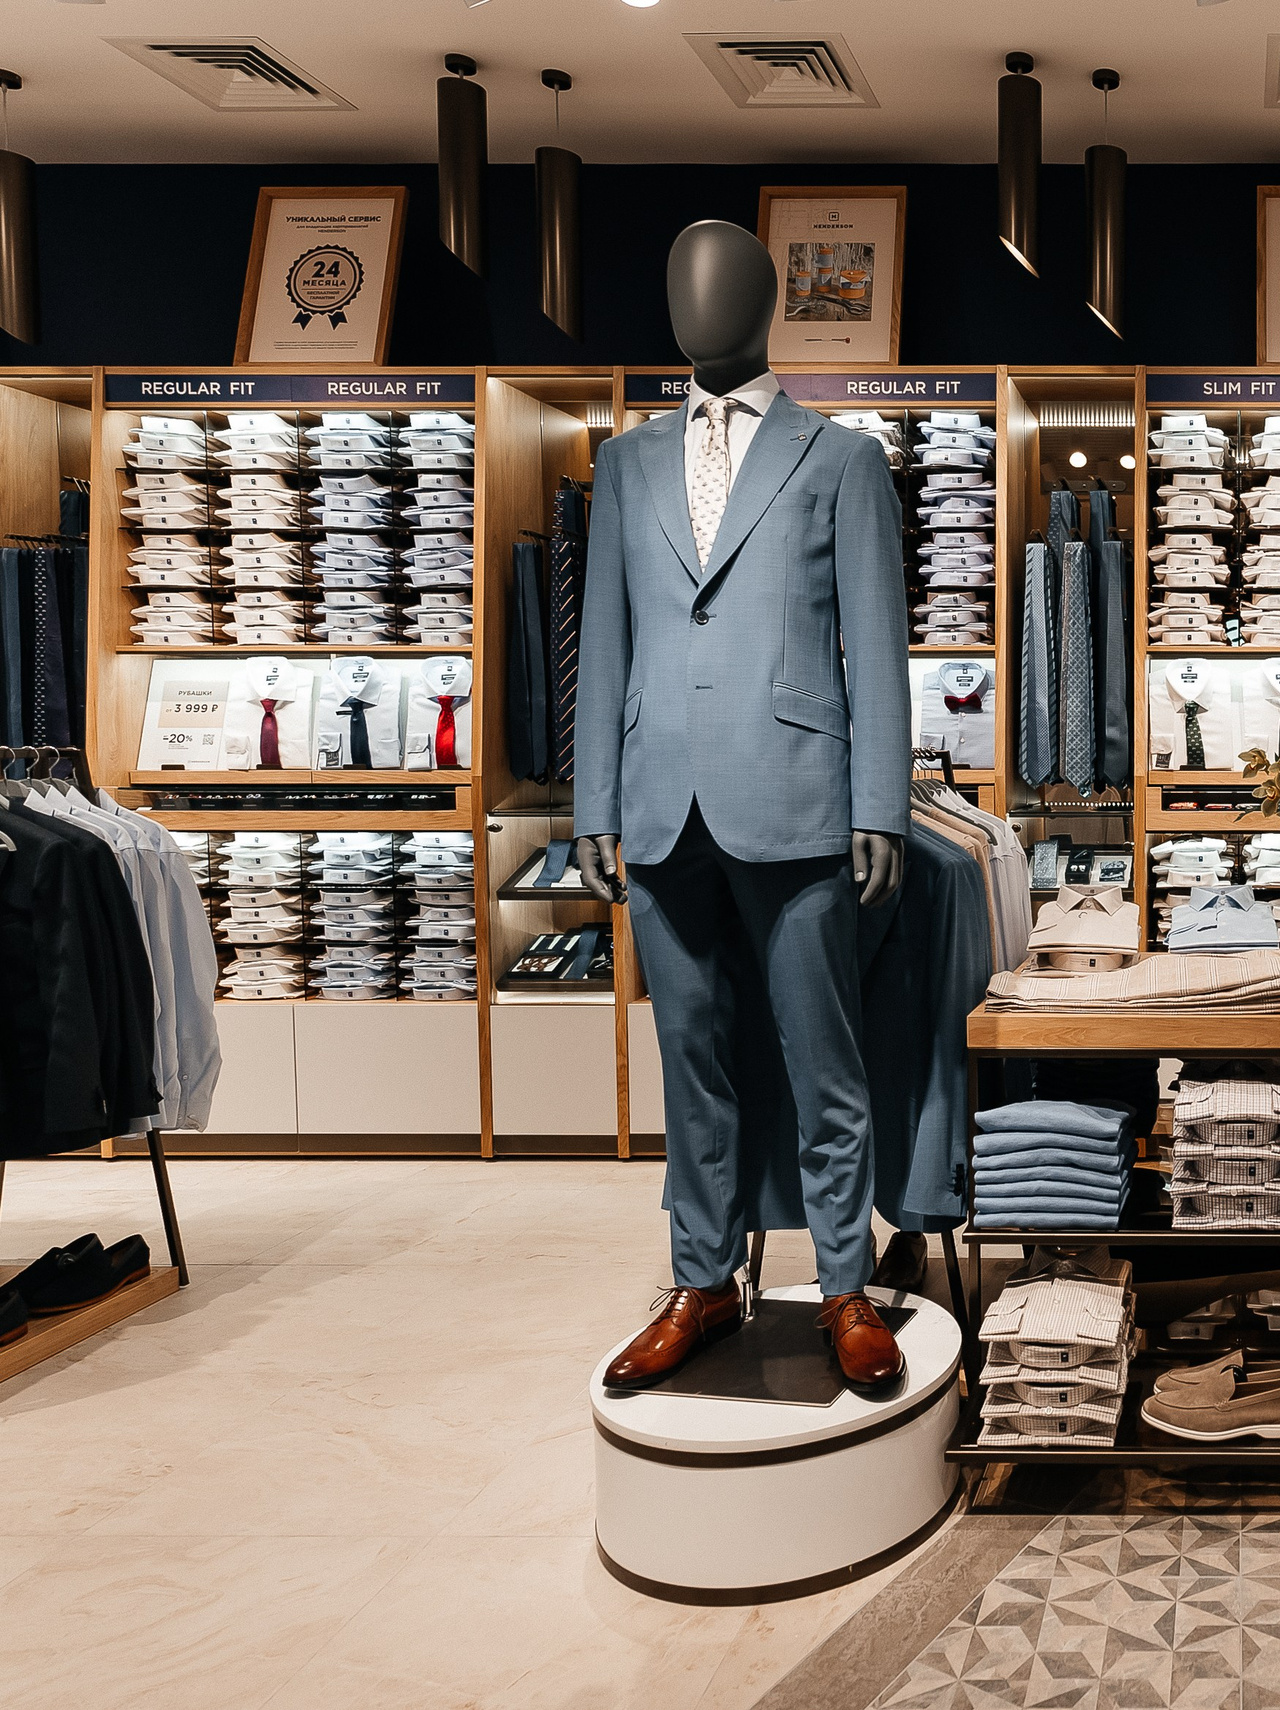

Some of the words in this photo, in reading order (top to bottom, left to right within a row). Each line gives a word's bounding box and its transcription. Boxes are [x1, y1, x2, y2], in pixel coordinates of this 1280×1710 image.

[285, 215, 346, 223] УНИКАЛЬНЫЙ
[312, 261, 340, 278] 24
[141, 382, 221, 395] REGULAR
[230, 382, 255, 395] FIT
[328, 382, 407, 395] REGULAR
[417, 382, 441, 395] FIT
[847, 381, 926, 394] REGULAR
[936, 381, 961, 394] FIT
[1203, 382, 1241, 395] SLIM
[1251, 382, 1276, 395] FIT
[174, 704, 182, 713] 3
[185, 704, 209, 713] 999
